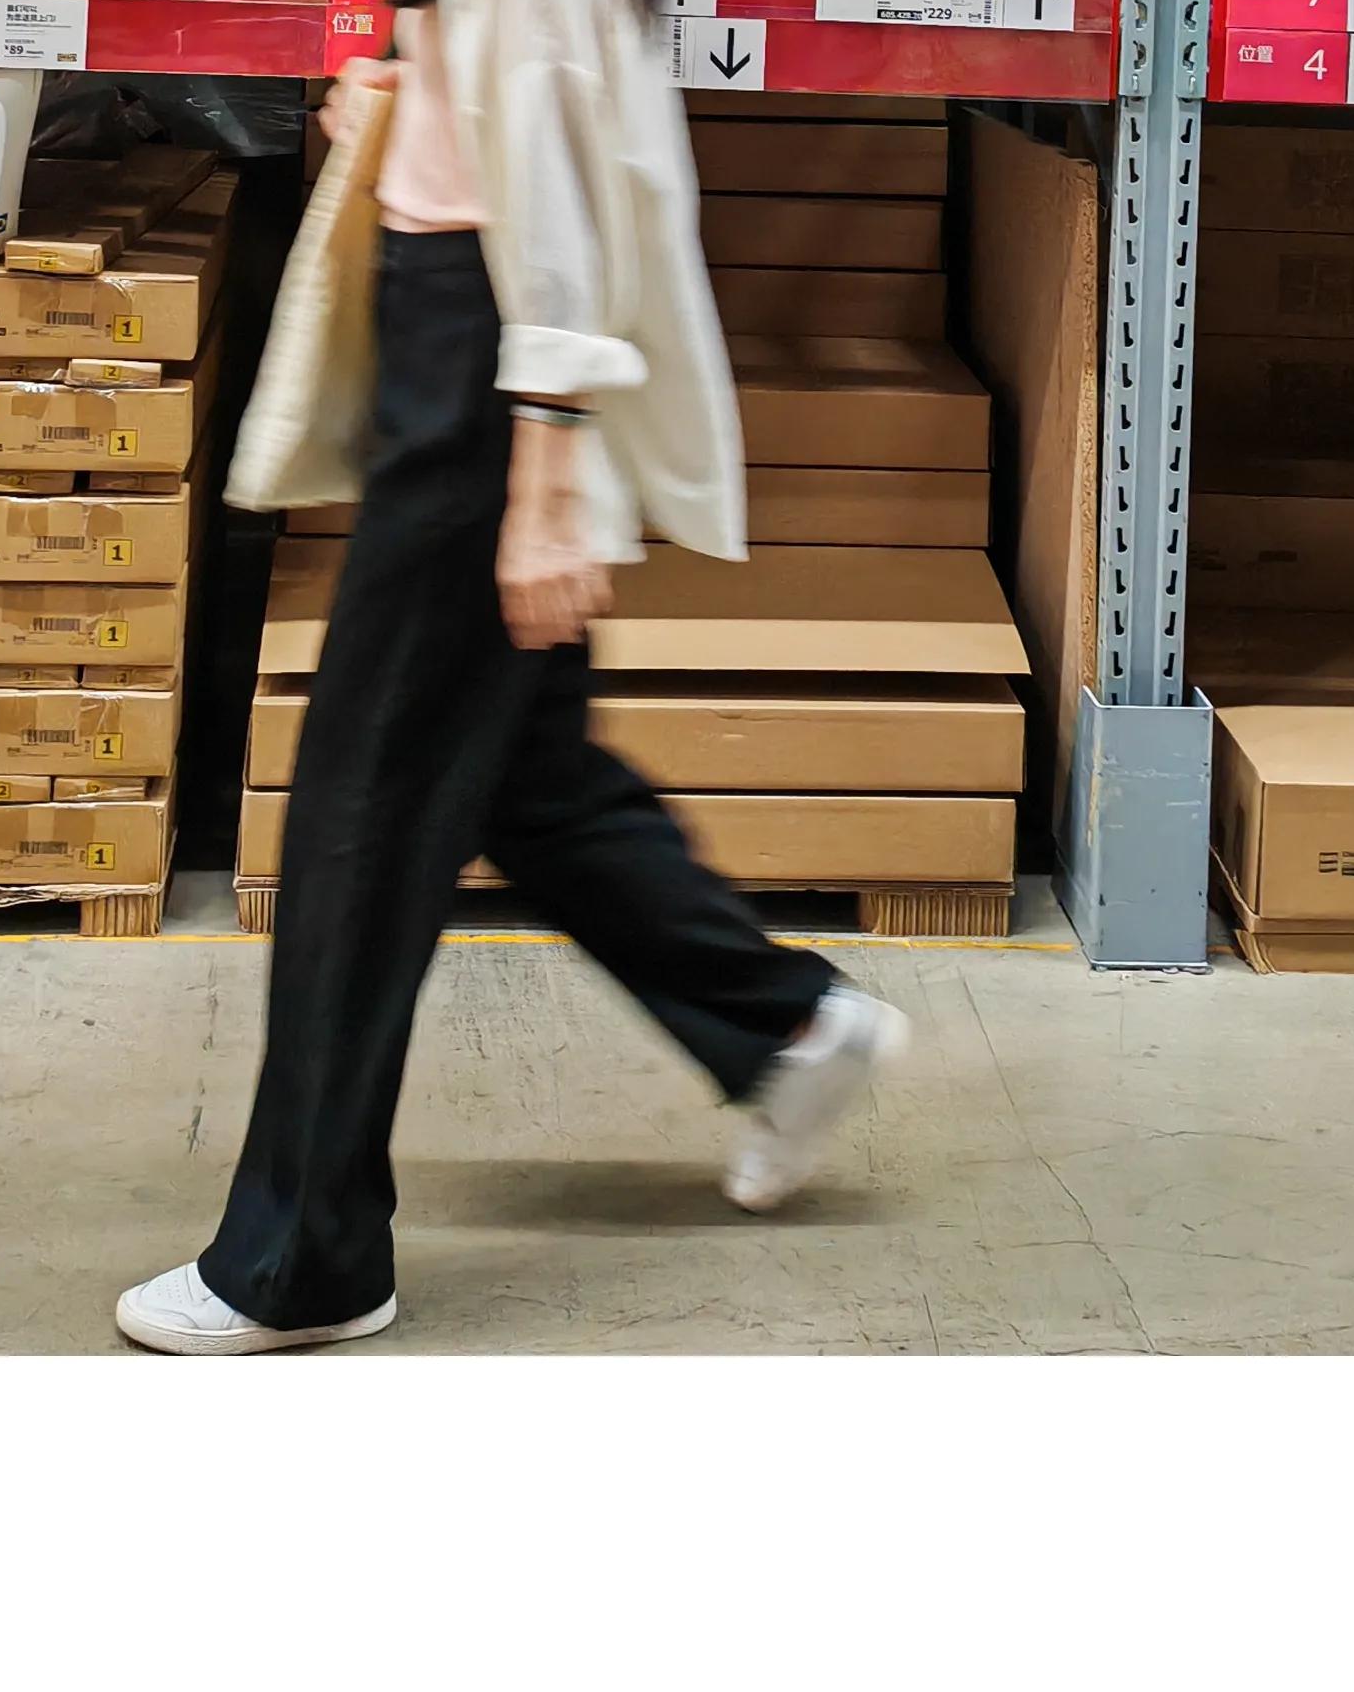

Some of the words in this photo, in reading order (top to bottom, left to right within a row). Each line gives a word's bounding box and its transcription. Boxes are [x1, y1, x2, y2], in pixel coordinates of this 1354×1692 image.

[332, 12, 374, 34] 位置
[1238, 44, 1274, 63] 位置
[1303, 49, 1328, 81] 4
